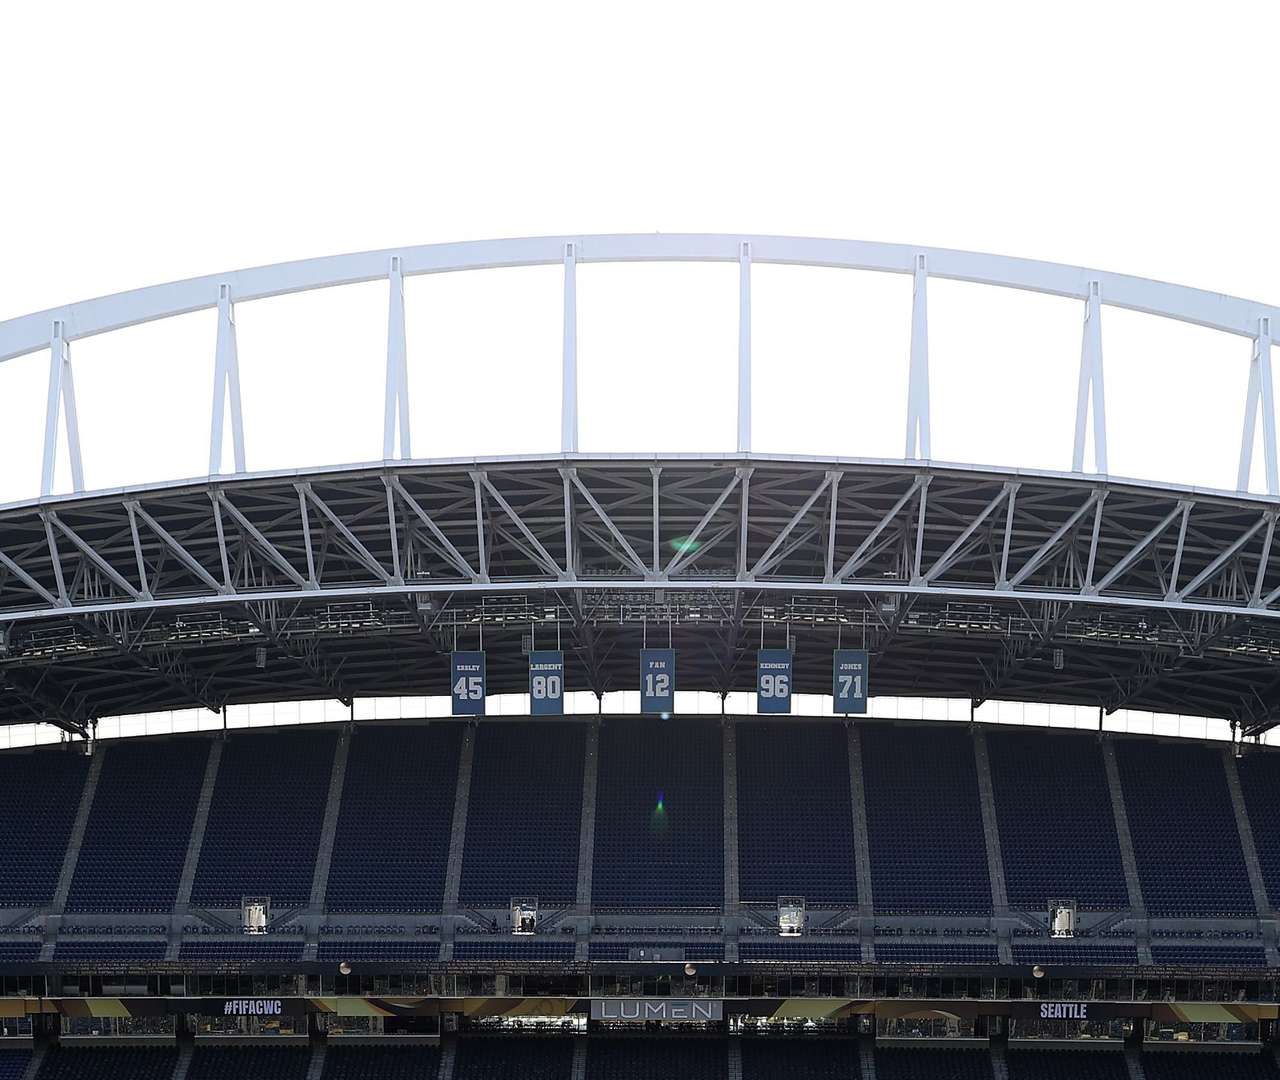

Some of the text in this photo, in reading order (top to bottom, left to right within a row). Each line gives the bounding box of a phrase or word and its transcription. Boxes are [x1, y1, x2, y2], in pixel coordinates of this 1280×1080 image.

[453, 676, 483, 700] 45
[532, 676, 561, 699] 80
[645, 673, 669, 697] 12
[760, 674, 789, 698] 96
[838, 675, 863, 698] 71
[224, 1000, 282, 1015] #FIFACWC
[601, 1002, 712, 1018] LUMEN
[1040, 1003, 1087, 1018] SEATTLE
